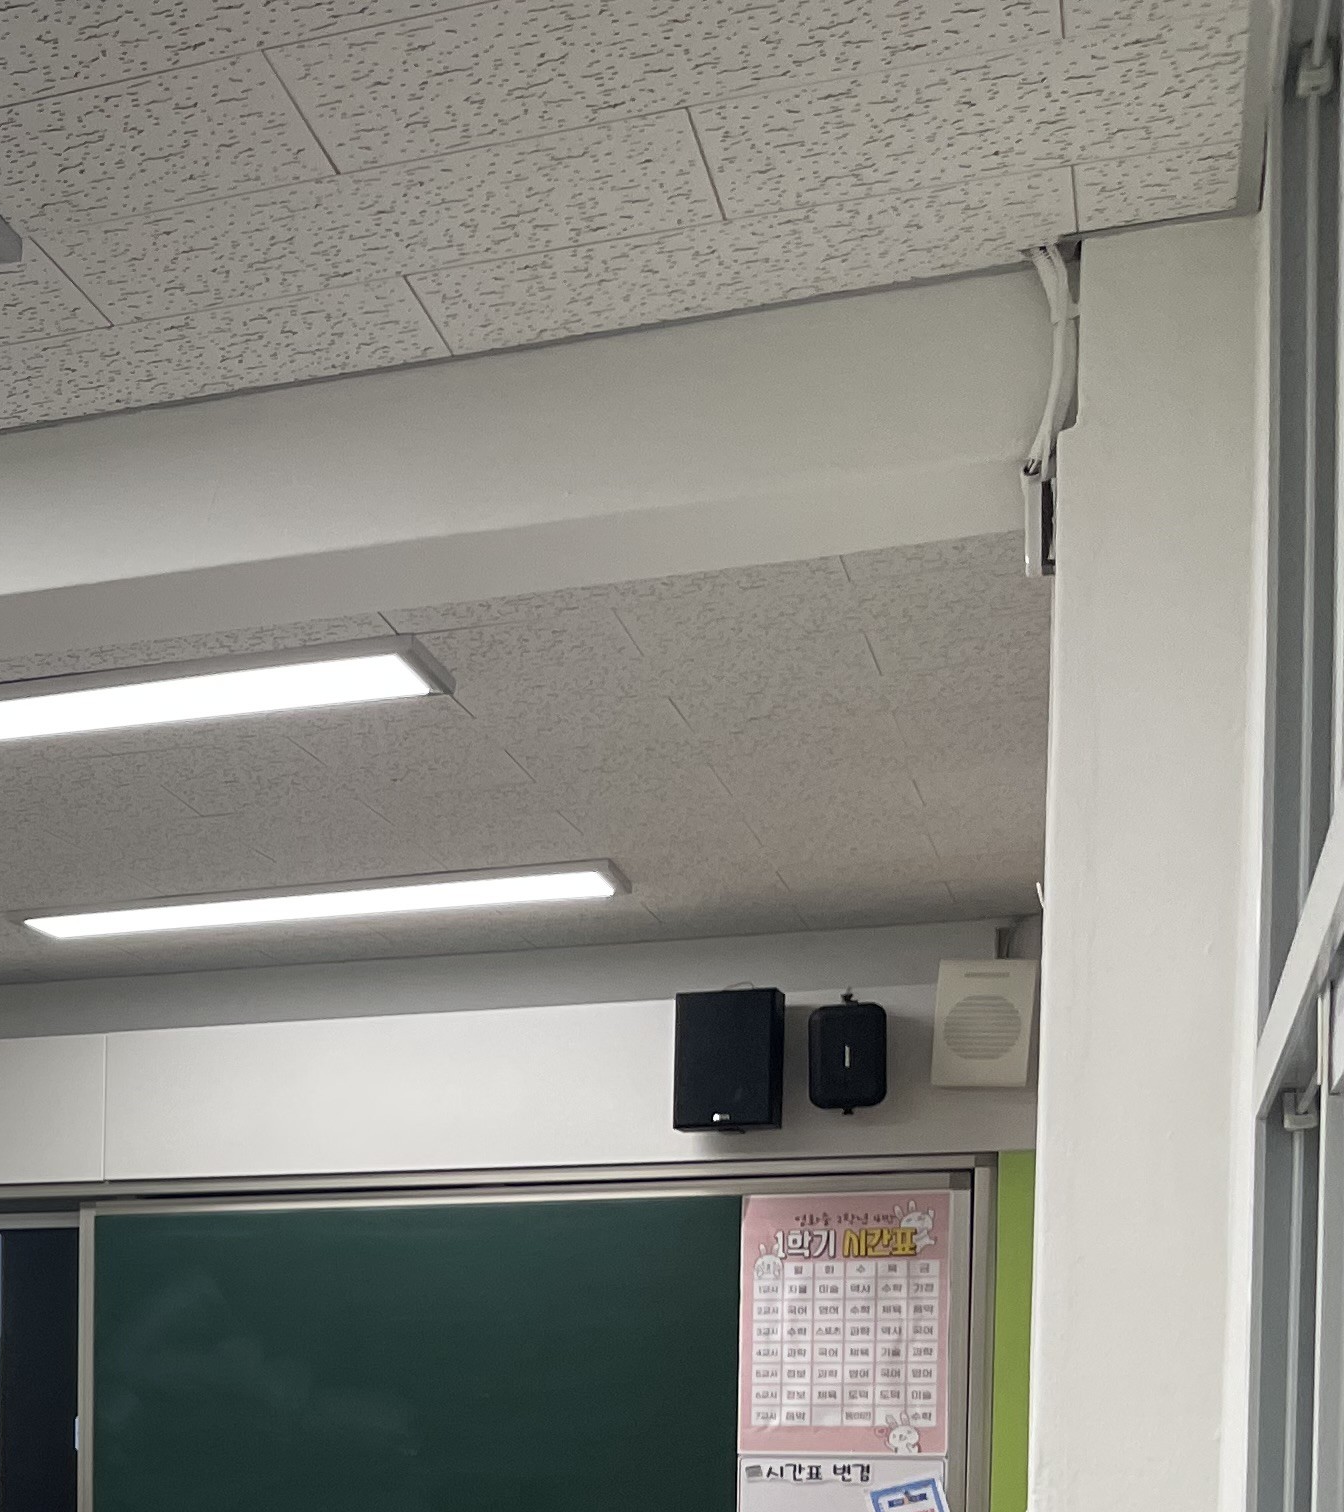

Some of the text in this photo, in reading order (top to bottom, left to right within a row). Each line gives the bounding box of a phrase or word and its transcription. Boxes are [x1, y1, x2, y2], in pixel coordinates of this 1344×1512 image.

[775, 1227, 917, 1259] 1학기 시간표
[766, 1464, 871, 1482] 시간표 변경
